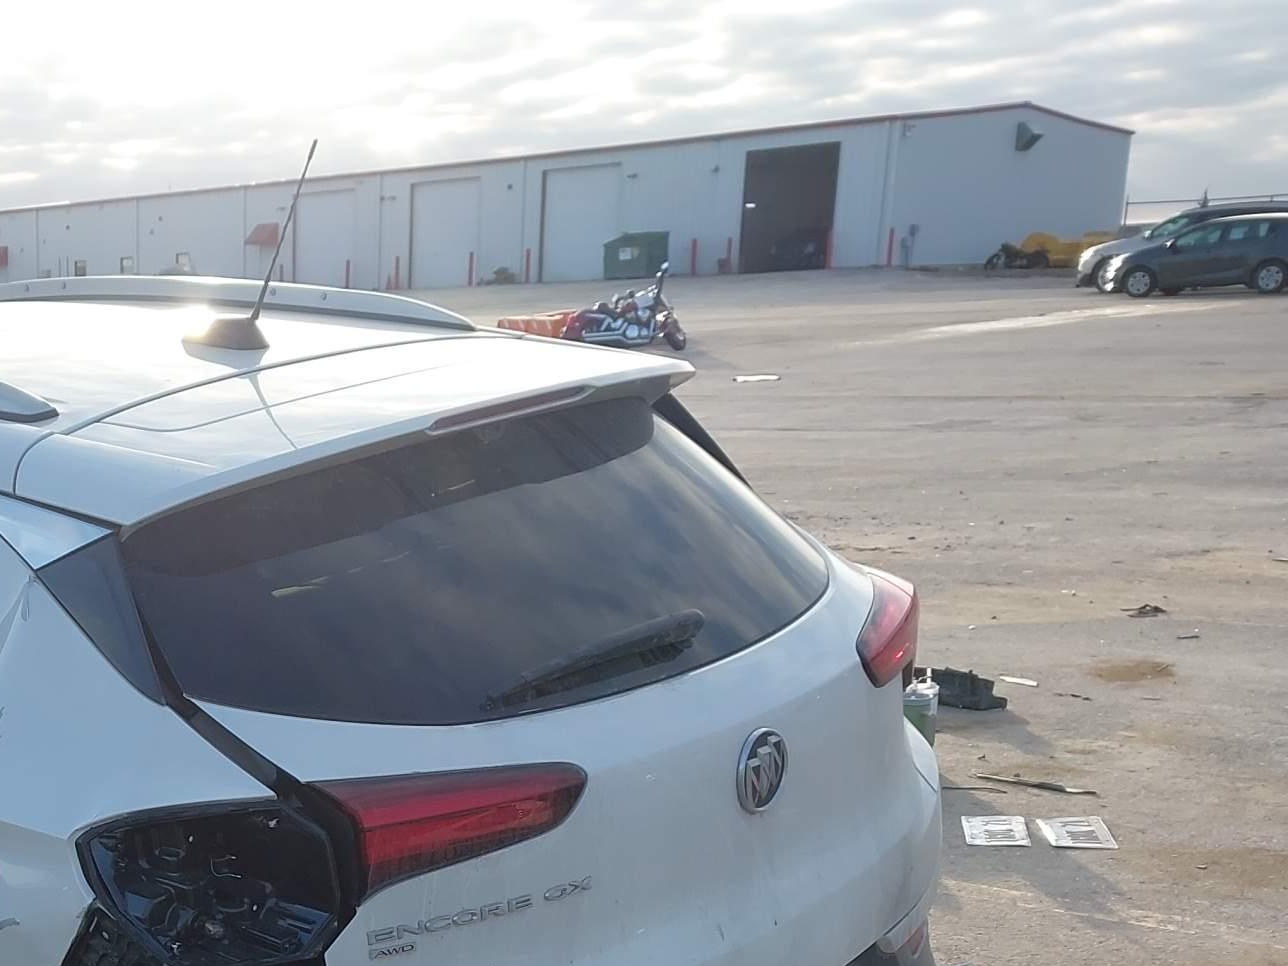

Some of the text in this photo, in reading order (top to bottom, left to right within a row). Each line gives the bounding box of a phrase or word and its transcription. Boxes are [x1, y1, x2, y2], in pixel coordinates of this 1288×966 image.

[367, 875, 593, 946] ENCORE GX
[373, 943, 415, 959] AWD
